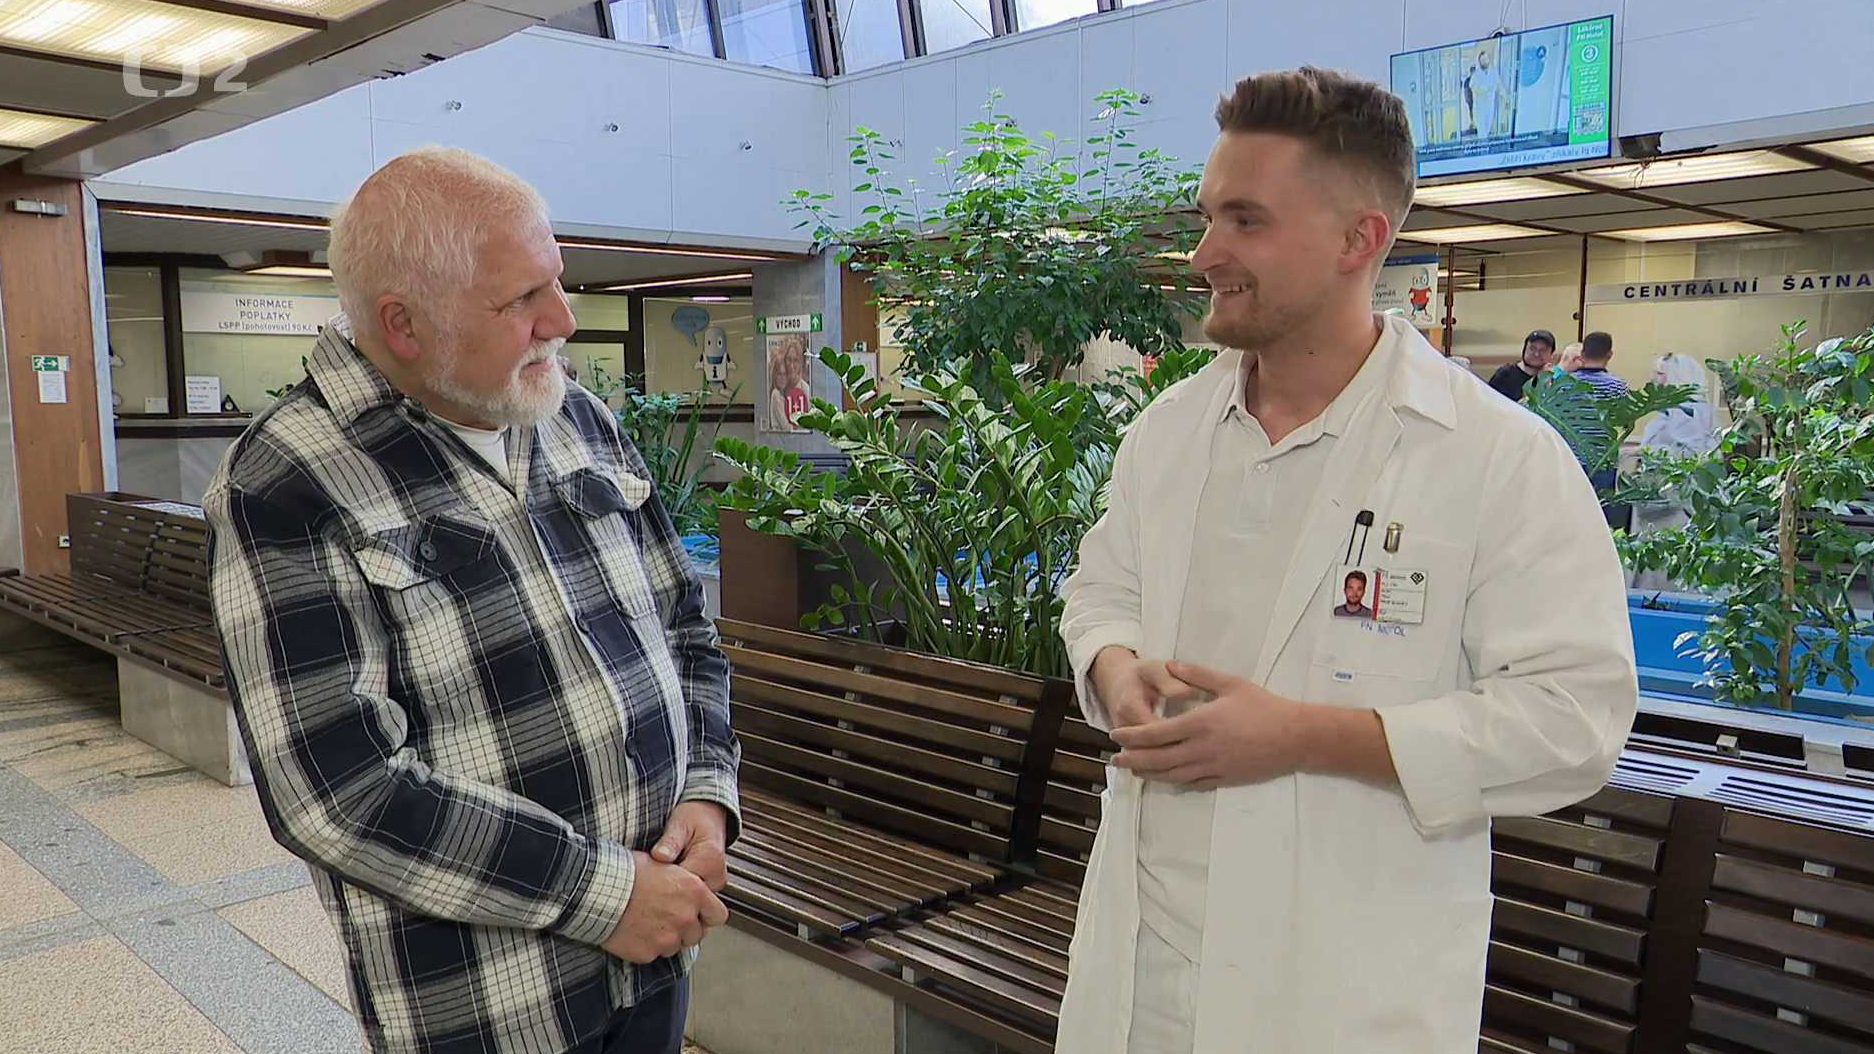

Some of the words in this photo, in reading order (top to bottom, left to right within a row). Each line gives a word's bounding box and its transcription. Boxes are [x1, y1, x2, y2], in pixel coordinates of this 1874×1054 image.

[1623, 276, 1760, 299] CENTRÁLNÍ
[1782, 273, 1873, 291] ŠATNA
[235, 298, 295, 309] INFORMACE
[240, 310, 291, 321] POPLATKY
[218, 321, 241, 330] LSPP
[775, 318, 801, 329] VÝCHOD
